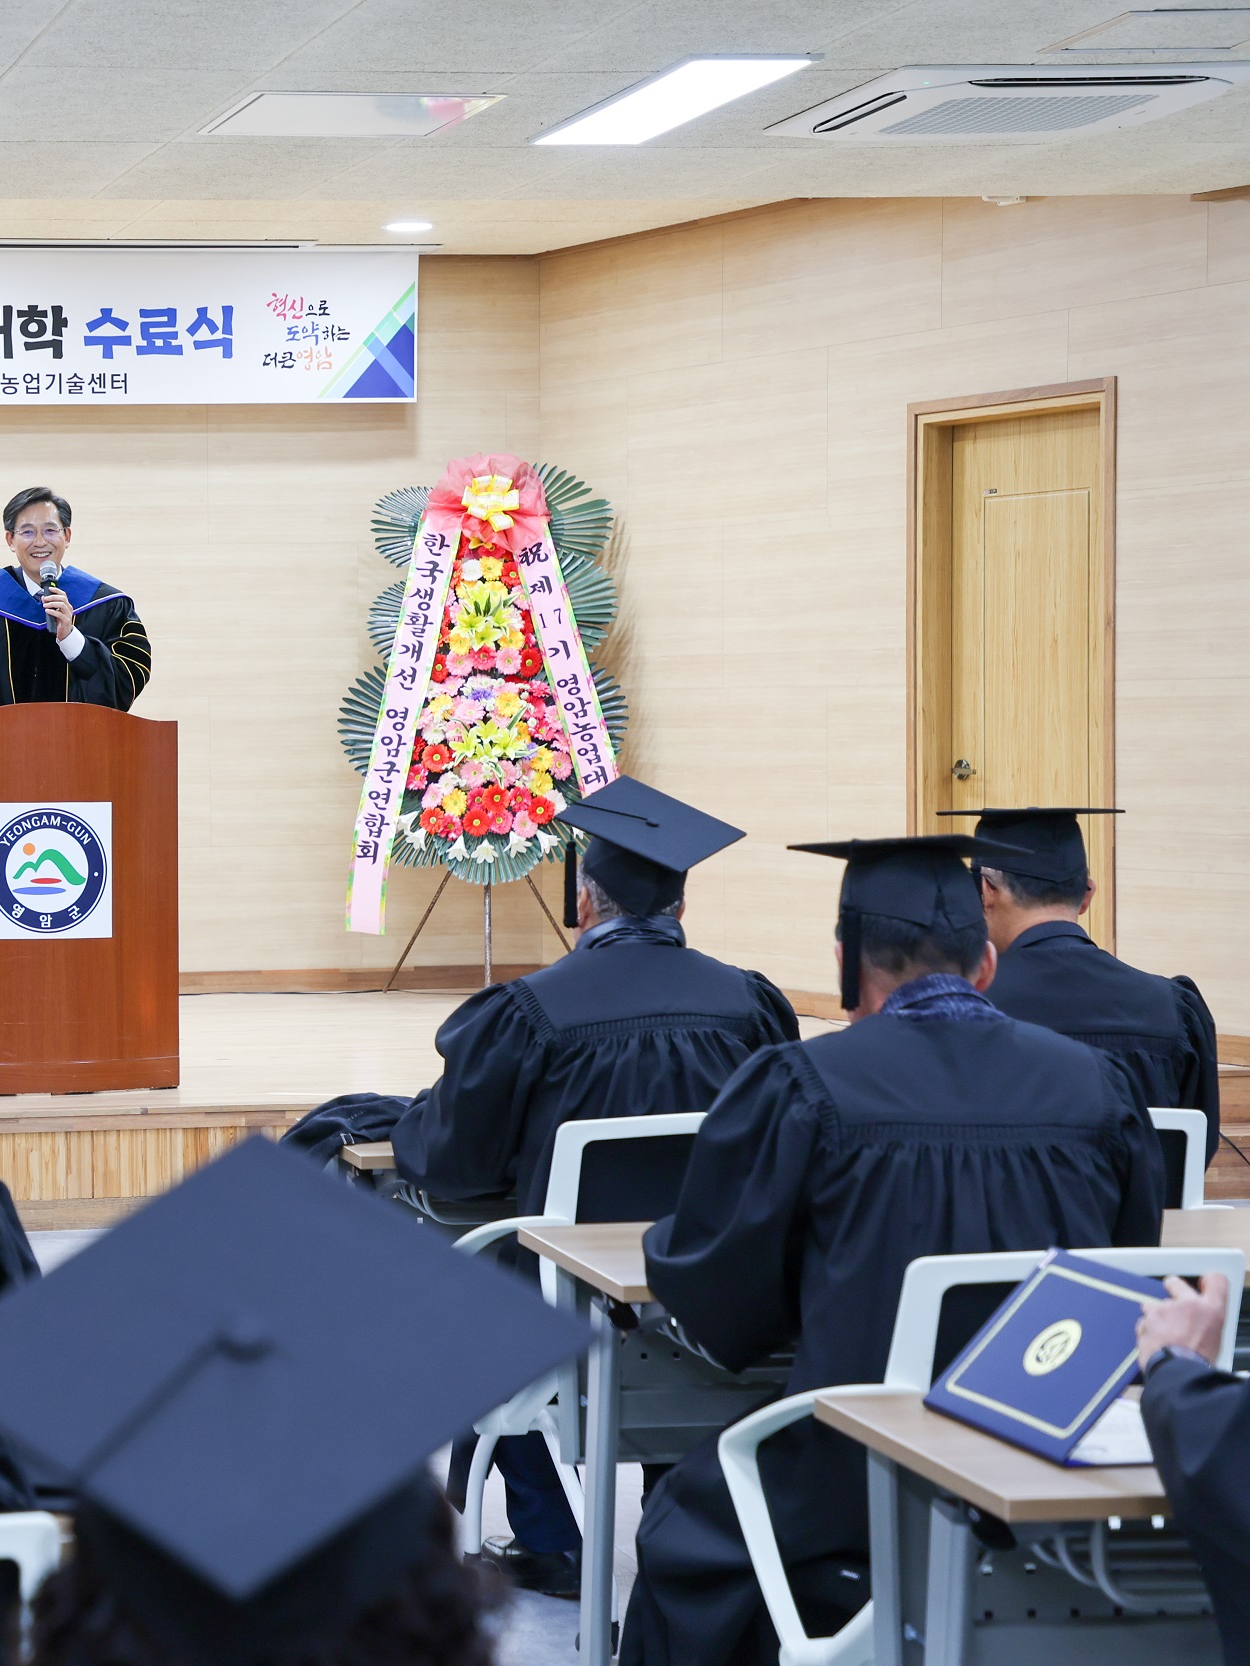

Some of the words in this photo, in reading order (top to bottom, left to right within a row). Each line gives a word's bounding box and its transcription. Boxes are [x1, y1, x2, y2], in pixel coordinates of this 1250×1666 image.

[266, 292, 330, 321] 혁신으로
[83, 305, 234, 360] 수료식
[286, 321, 350, 346] 도약하는
[519, 542, 549, 566] 祝
[392, 533, 450, 691] 한국생활개선
[356, 706, 409, 865] 영암군연합회
[0, 815, 92, 847] YEONGAM-GUN
[11, 903, 82, 928] 영암군
